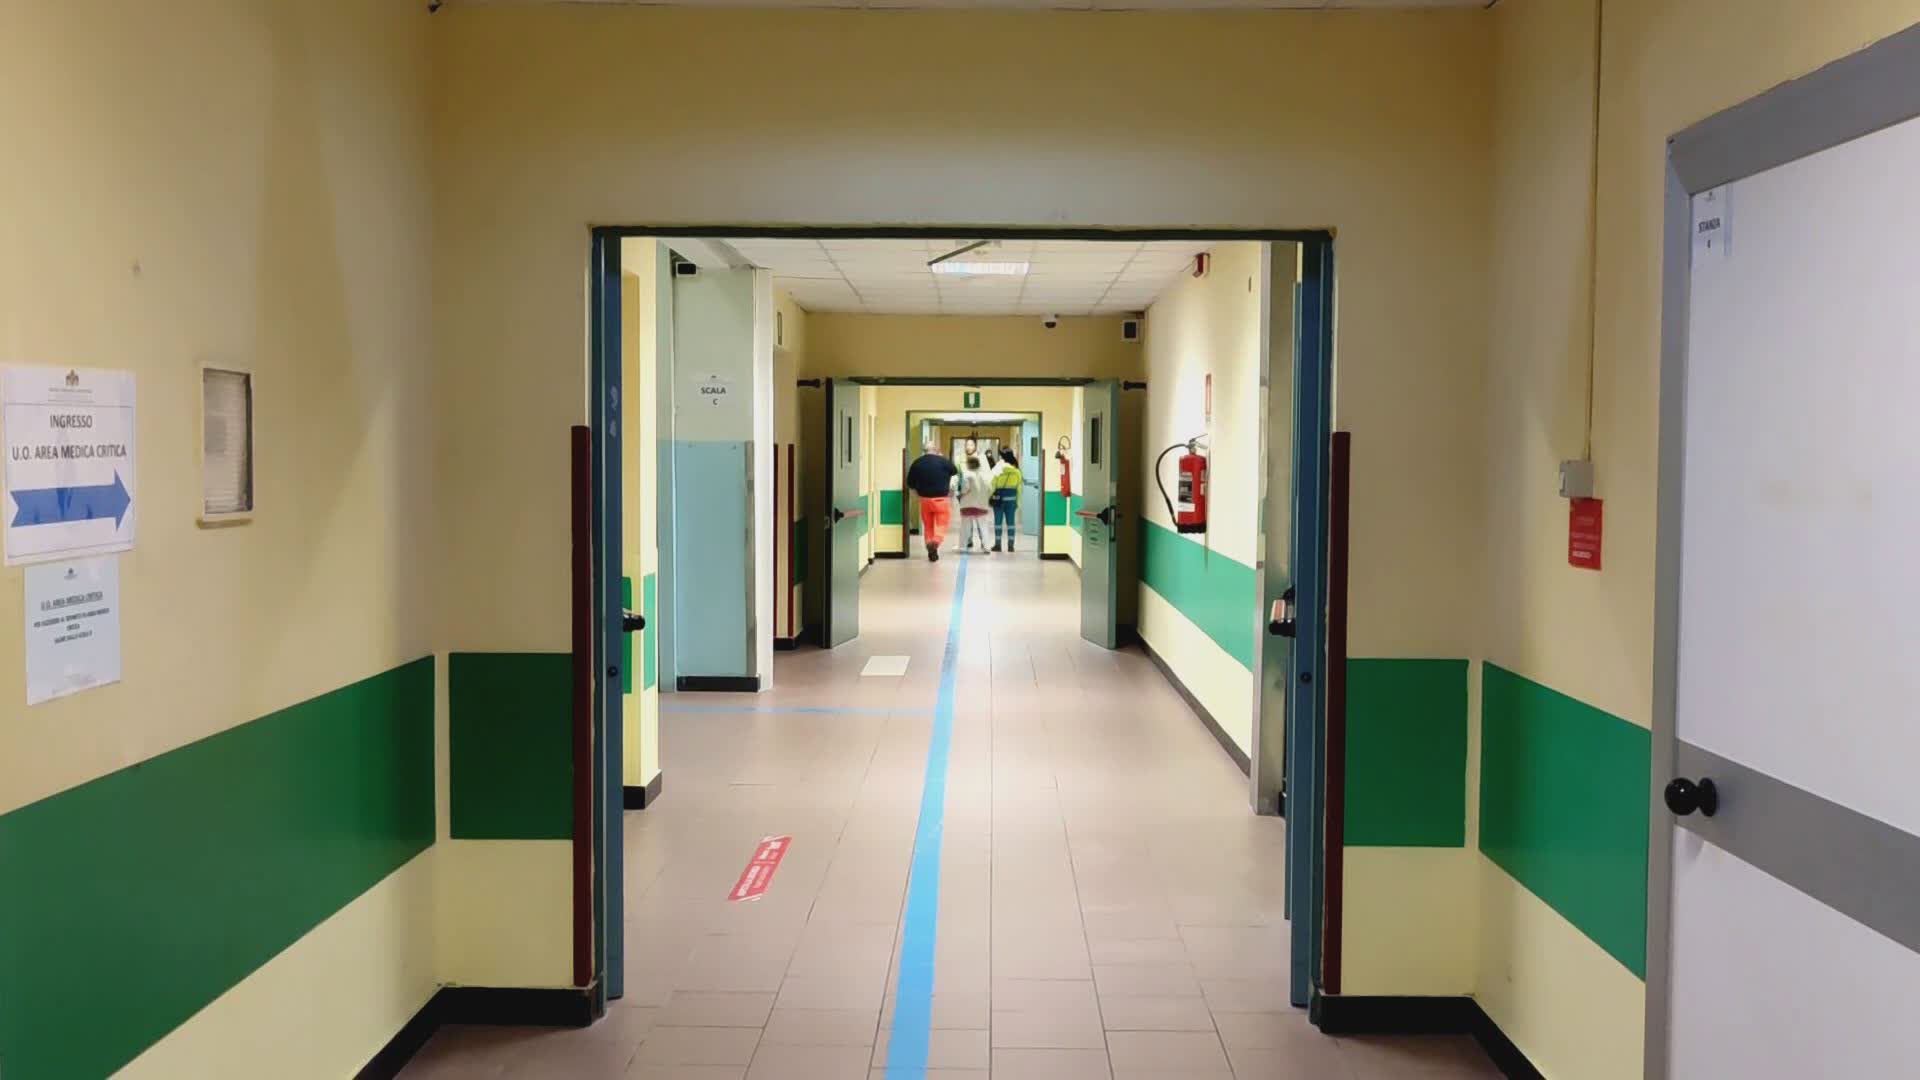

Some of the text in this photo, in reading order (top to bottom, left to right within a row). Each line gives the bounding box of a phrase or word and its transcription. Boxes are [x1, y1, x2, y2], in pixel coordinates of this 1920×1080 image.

[50, 415, 93, 428] INGRESSO
[12, 444, 127, 461] U.O. AREA MEDICA CRITICA
